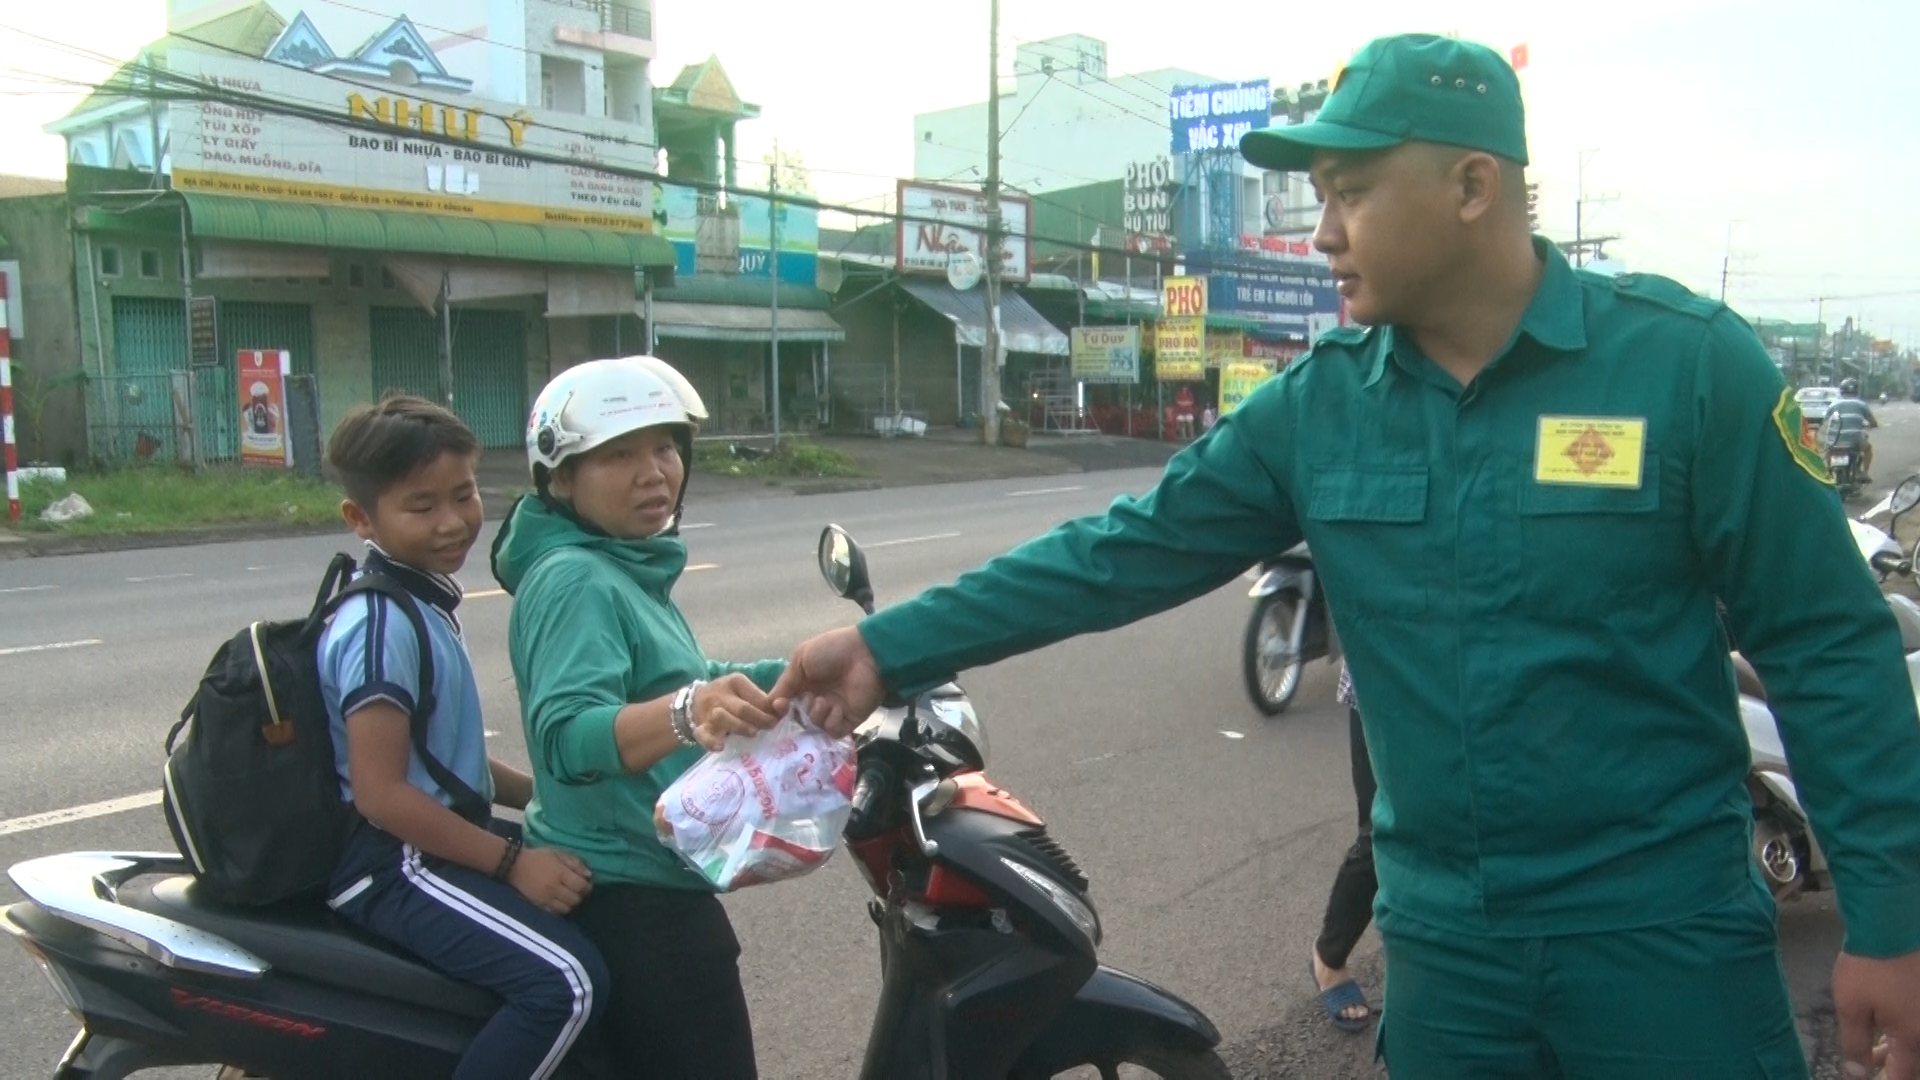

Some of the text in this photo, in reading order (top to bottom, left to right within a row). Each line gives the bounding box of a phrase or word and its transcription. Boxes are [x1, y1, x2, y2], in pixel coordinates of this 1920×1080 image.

[350, 134, 380, 151] BAO
[403, 142, 443, 160] NHỰA
[453, 149, 482, 164] BAO
[1166, 278, 1204, 315] PHỞ
